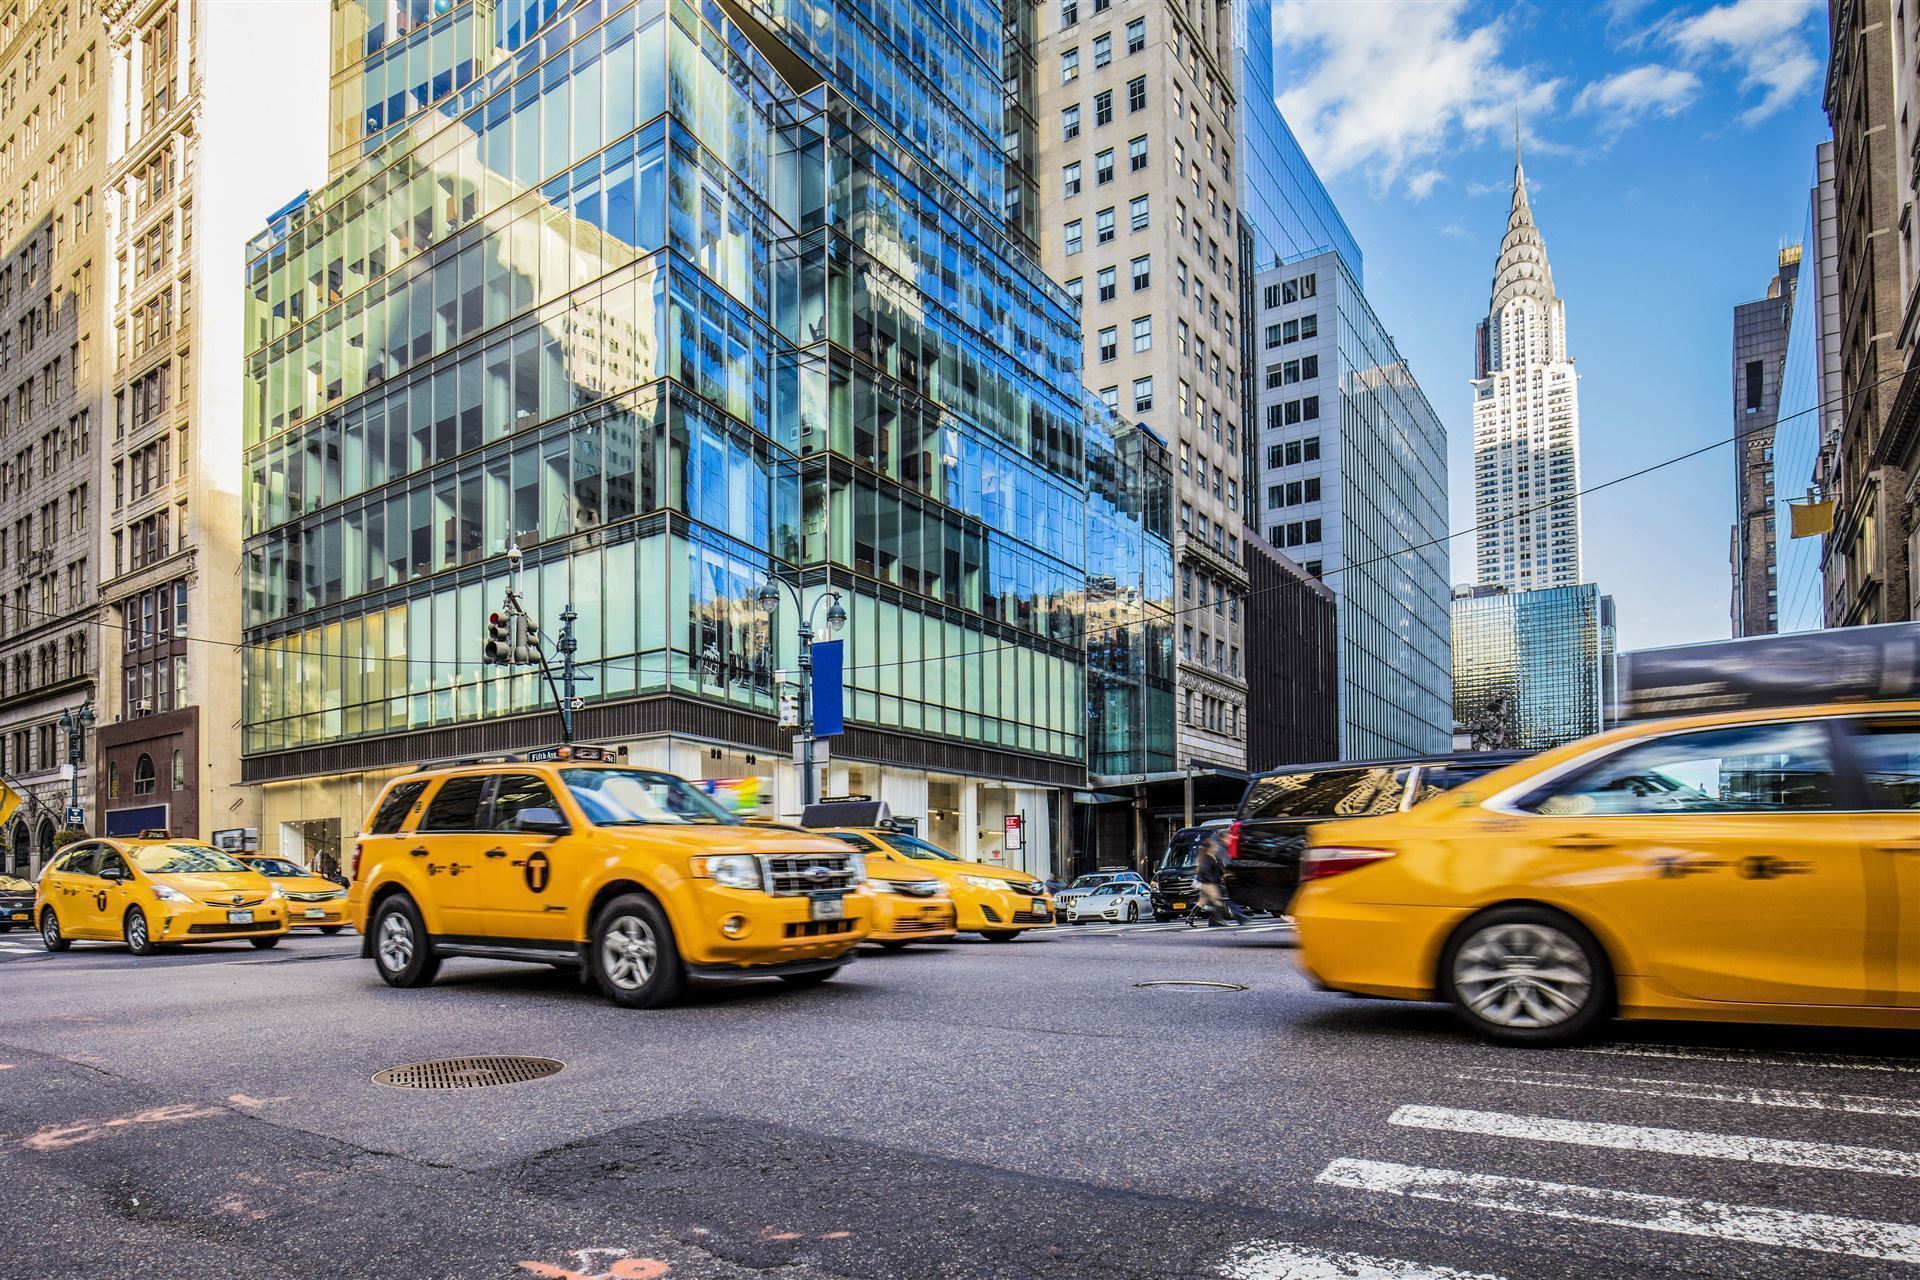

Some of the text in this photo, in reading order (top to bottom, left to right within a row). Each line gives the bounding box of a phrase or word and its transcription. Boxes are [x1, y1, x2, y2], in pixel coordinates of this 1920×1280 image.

[531, 752, 547, 761] Fifth
[606, 754, 614, 762] St
[528, 859, 546, 888] T
